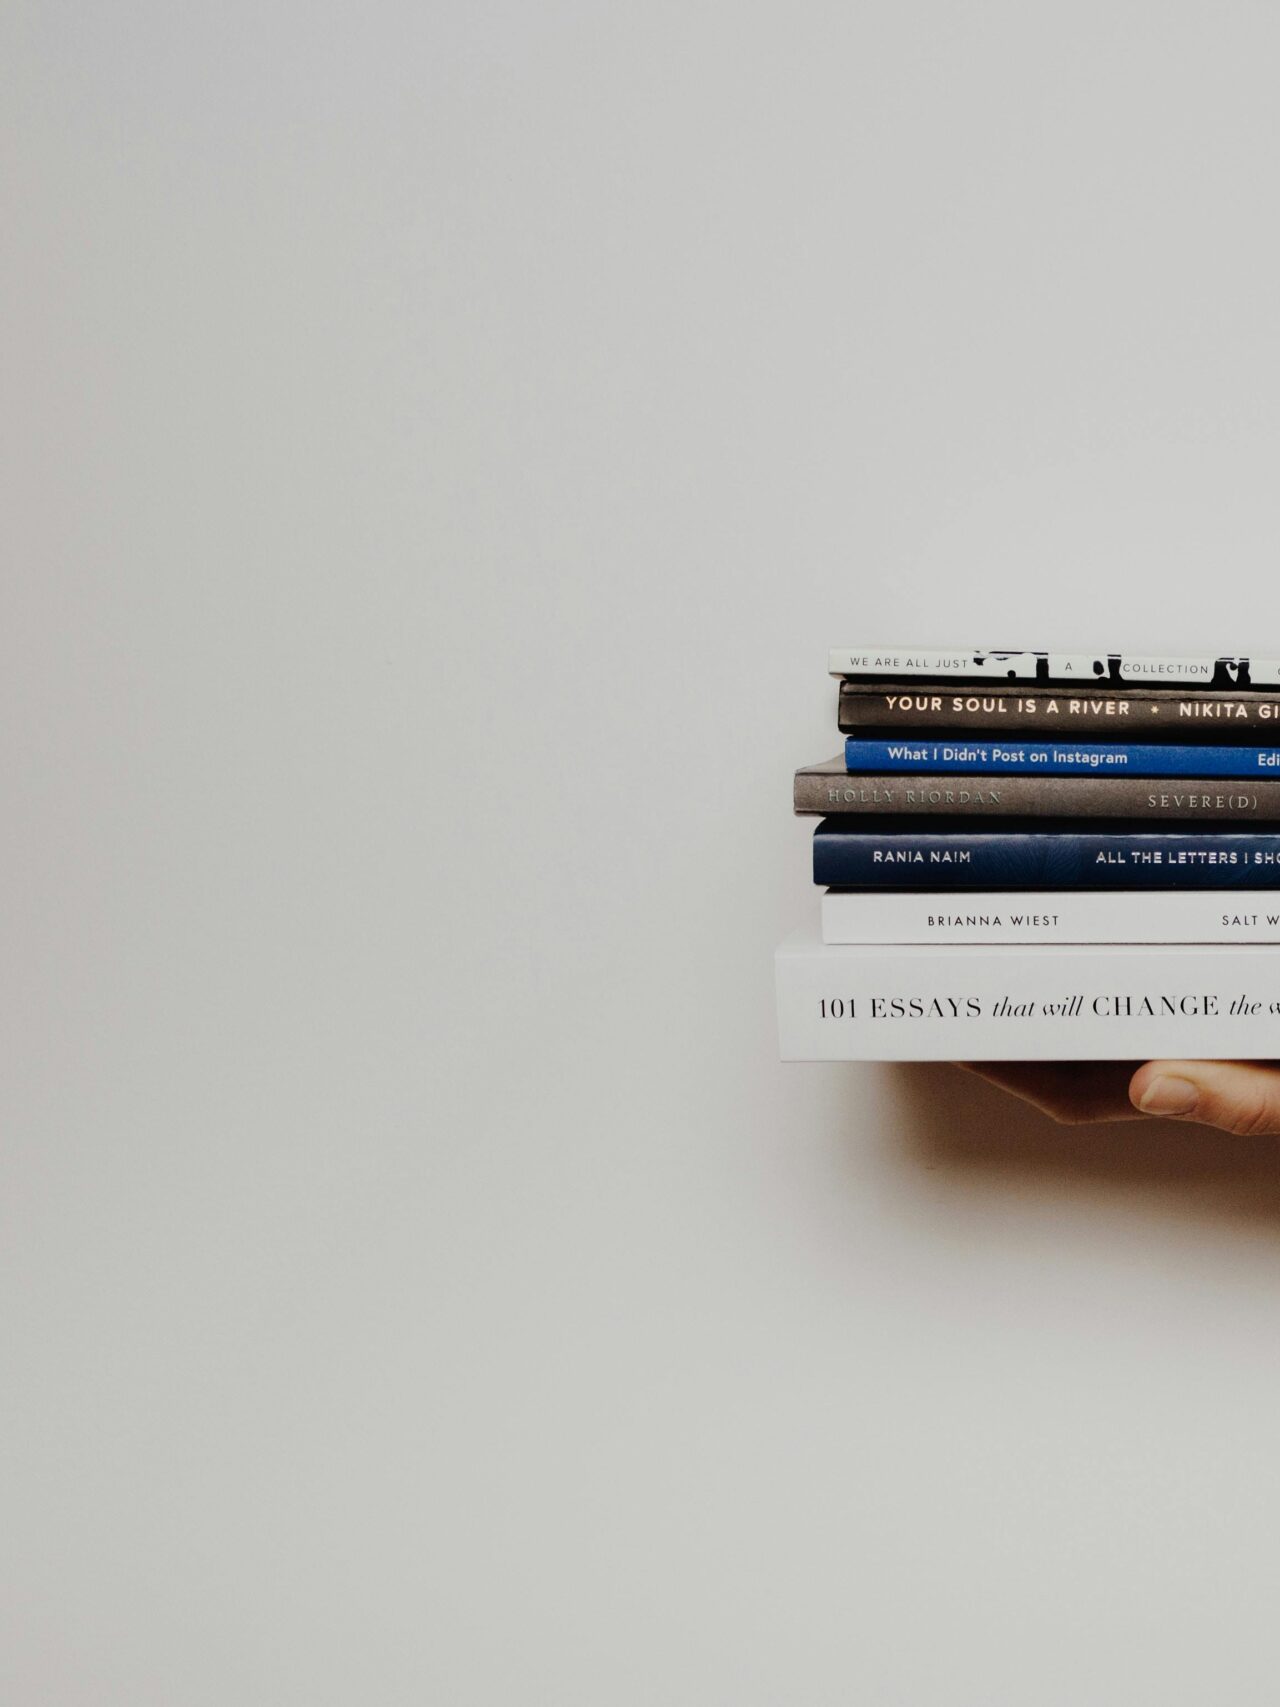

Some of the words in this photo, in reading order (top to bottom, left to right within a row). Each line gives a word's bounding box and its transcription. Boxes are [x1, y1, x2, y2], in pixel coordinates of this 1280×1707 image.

[850, 657, 871, 667] WE
[874, 657, 900, 668] ARE
[906, 658, 929, 668] ALL
[935, 659, 968, 669] JUST
[1065, 662, 1073, 671] A
[1122, 664, 1209, 674] COLLECTION
[886, 696, 943, 711] YOUR
[952, 698, 1007, 712] SOUL
[1018, 698, 1036, 713] IS
[1047, 699, 1059, 714] A
[1069, 700, 1130, 716] RIVER
[1179, 702, 1248, 718] NIKITA
[888, 747, 929, 761] What
[933, 748, 938, 761] I
[943, 748, 987, 762] Didn't
[992, 749, 1026, 762] Post
[1030, 753, 1048, 763] on
[1053, 750, 1128, 767] Instagram
[828, 789, 896, 803] HOLLY
[905, 791, 1001, 804] RIORDAN
[1148, 794, 1258, 809] SEVERE(D)
[872, 851, 924, 863] RANIA
[930, 851, 971, 863] NAIM
[1096, 852, 1126, 864] ALL
[1131, 852, 1162, 864] THE
[1168, 852, 1238, 864] LETTERS
[1244, 853, 1248, 864] I
[928, 916, 1002, 926] BRIANNA
[1010, 916, 1059, 926] WIEST
[1222, 915, 1258, 926] SALT
[818, 999, 856, 1018] 101
[871, 998, 981, 1018] ESSAYS
[992, 997, 1036, 1017] that
[1042, 996, 1084, 1017] will
[1092, 996, 1219, 1017] CHANGE
[1229, 994, 1261, 1015] the
